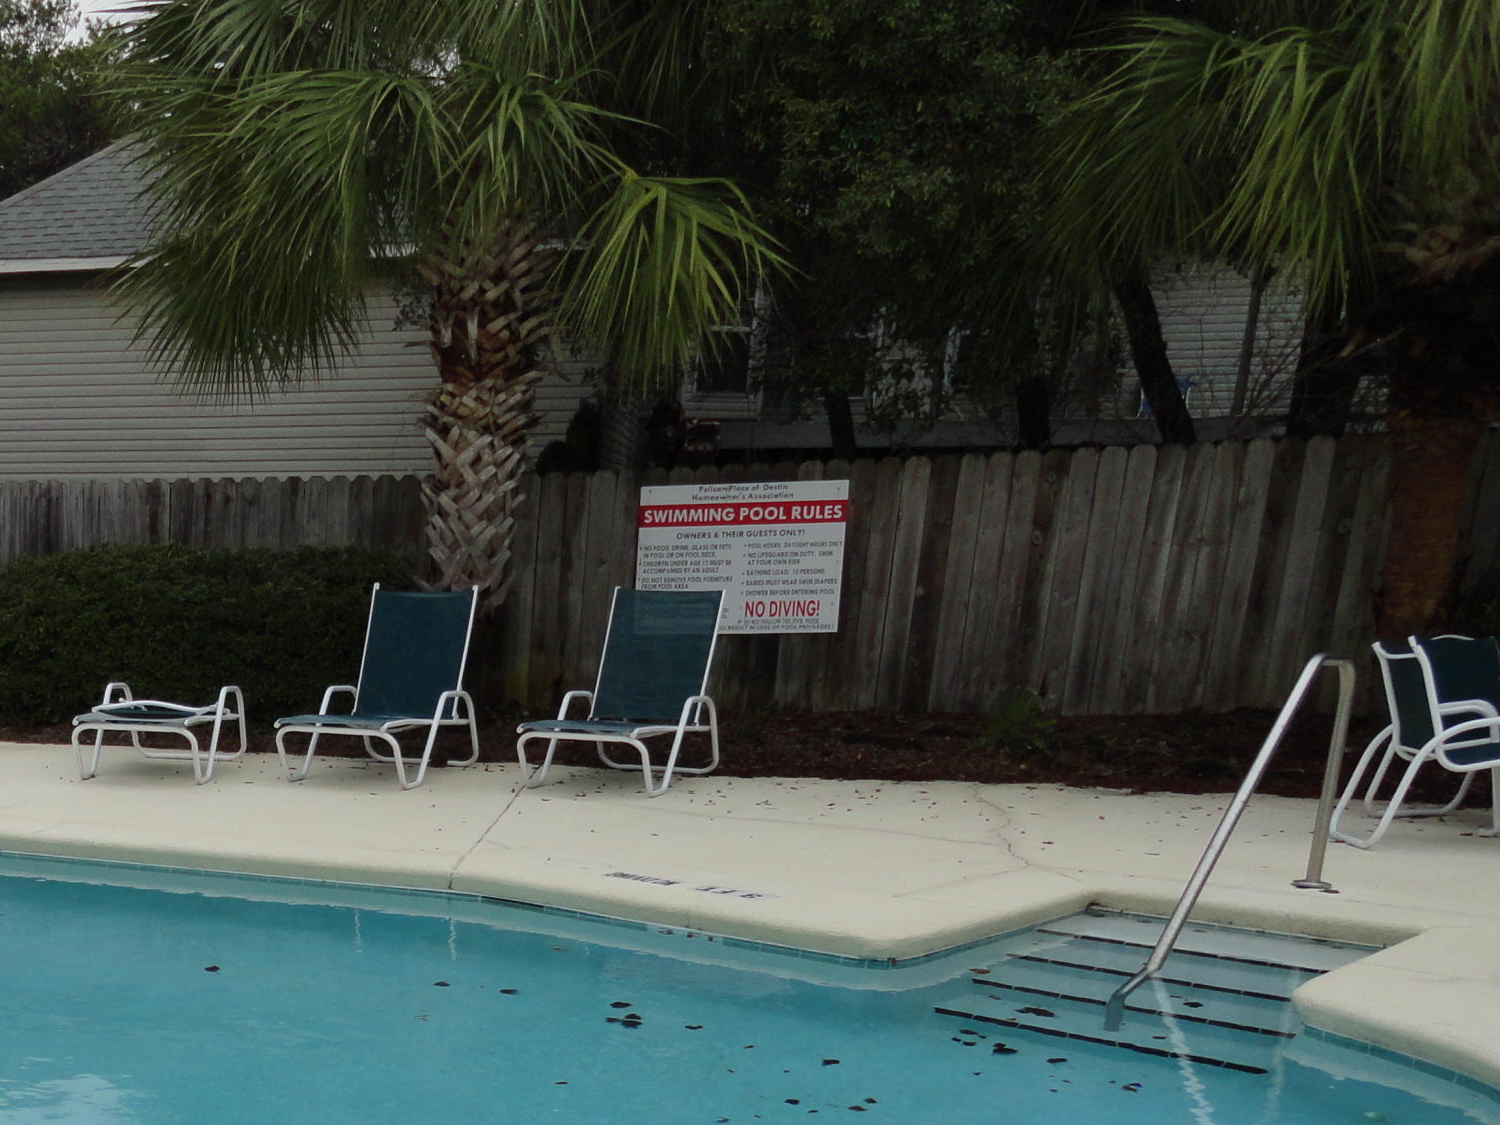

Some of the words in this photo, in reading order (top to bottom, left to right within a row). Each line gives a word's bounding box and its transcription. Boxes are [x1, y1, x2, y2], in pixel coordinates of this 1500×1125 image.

[748, 492, 794, 500] Association
[643, 508, 735, 523] SWIMMING
[739, 506, 787, 521] POOL
[791, 505, 843, 520] RULES
[676, 531, 711, 540] OWNERS
[746, 529, 778, 537] GUESTS
[745, 601, 765, 617] NO
[769, 600, 820, 617] DIVING!
